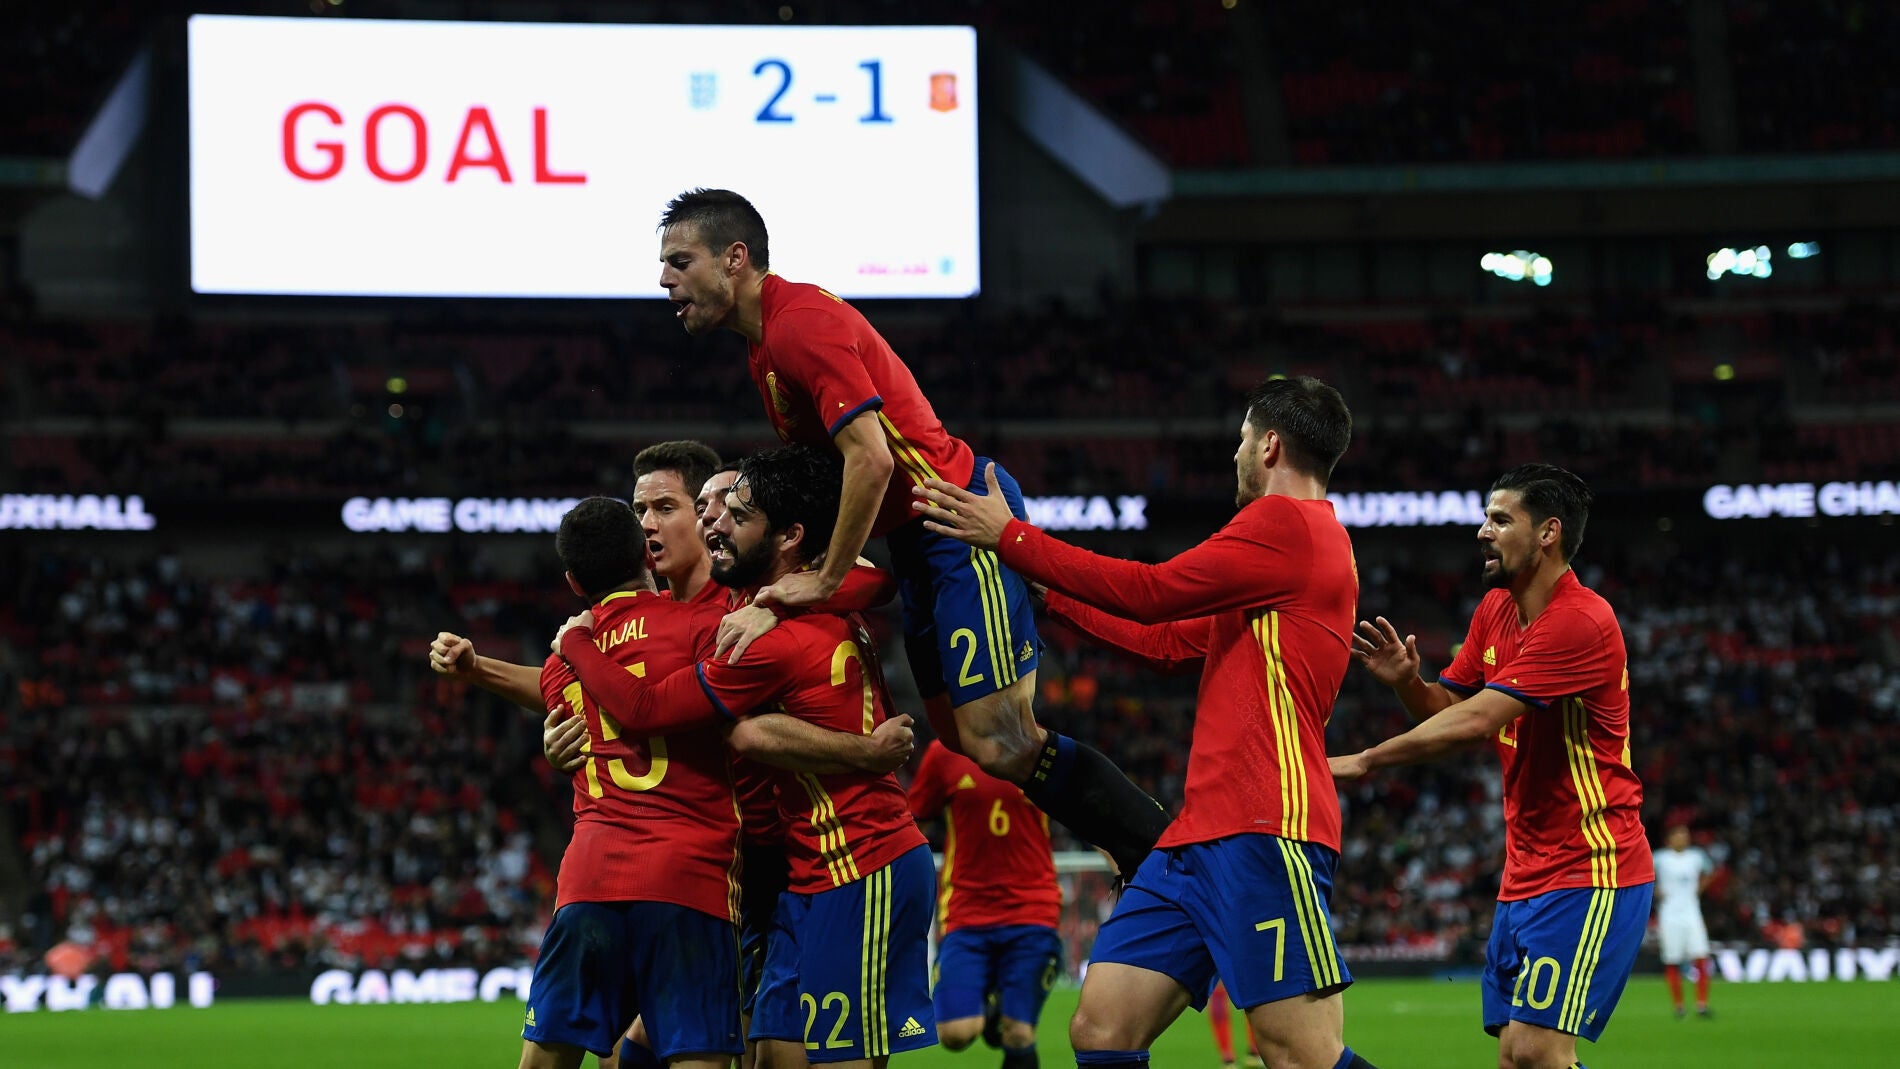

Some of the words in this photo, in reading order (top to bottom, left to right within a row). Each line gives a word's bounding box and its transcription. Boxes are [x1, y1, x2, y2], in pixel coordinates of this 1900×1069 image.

[751, 58, 795, 124] 2
[858, 60, 893, 124] 1
[281, 101, 588, 184] GOAL
[341, 497, 452, 532] GAME
[1116, 494, 1147, 531] X
[1327, 490, 1490, 528] AUXHAL
[1703, 483, 1816, 519] GAME
[1818, 481, 1900, 517] CHA
[950, 628, 984, 687] 2
[989, 799, 1011, 836] 6
[1256, 917, 1287, 982] 7
[310, 968, 478, 1005] GAME
[1511, 955, 1561, 1010] 20
[800, 991, 854, 1051] 22
[898, 1027, 926, 1038] adidas
